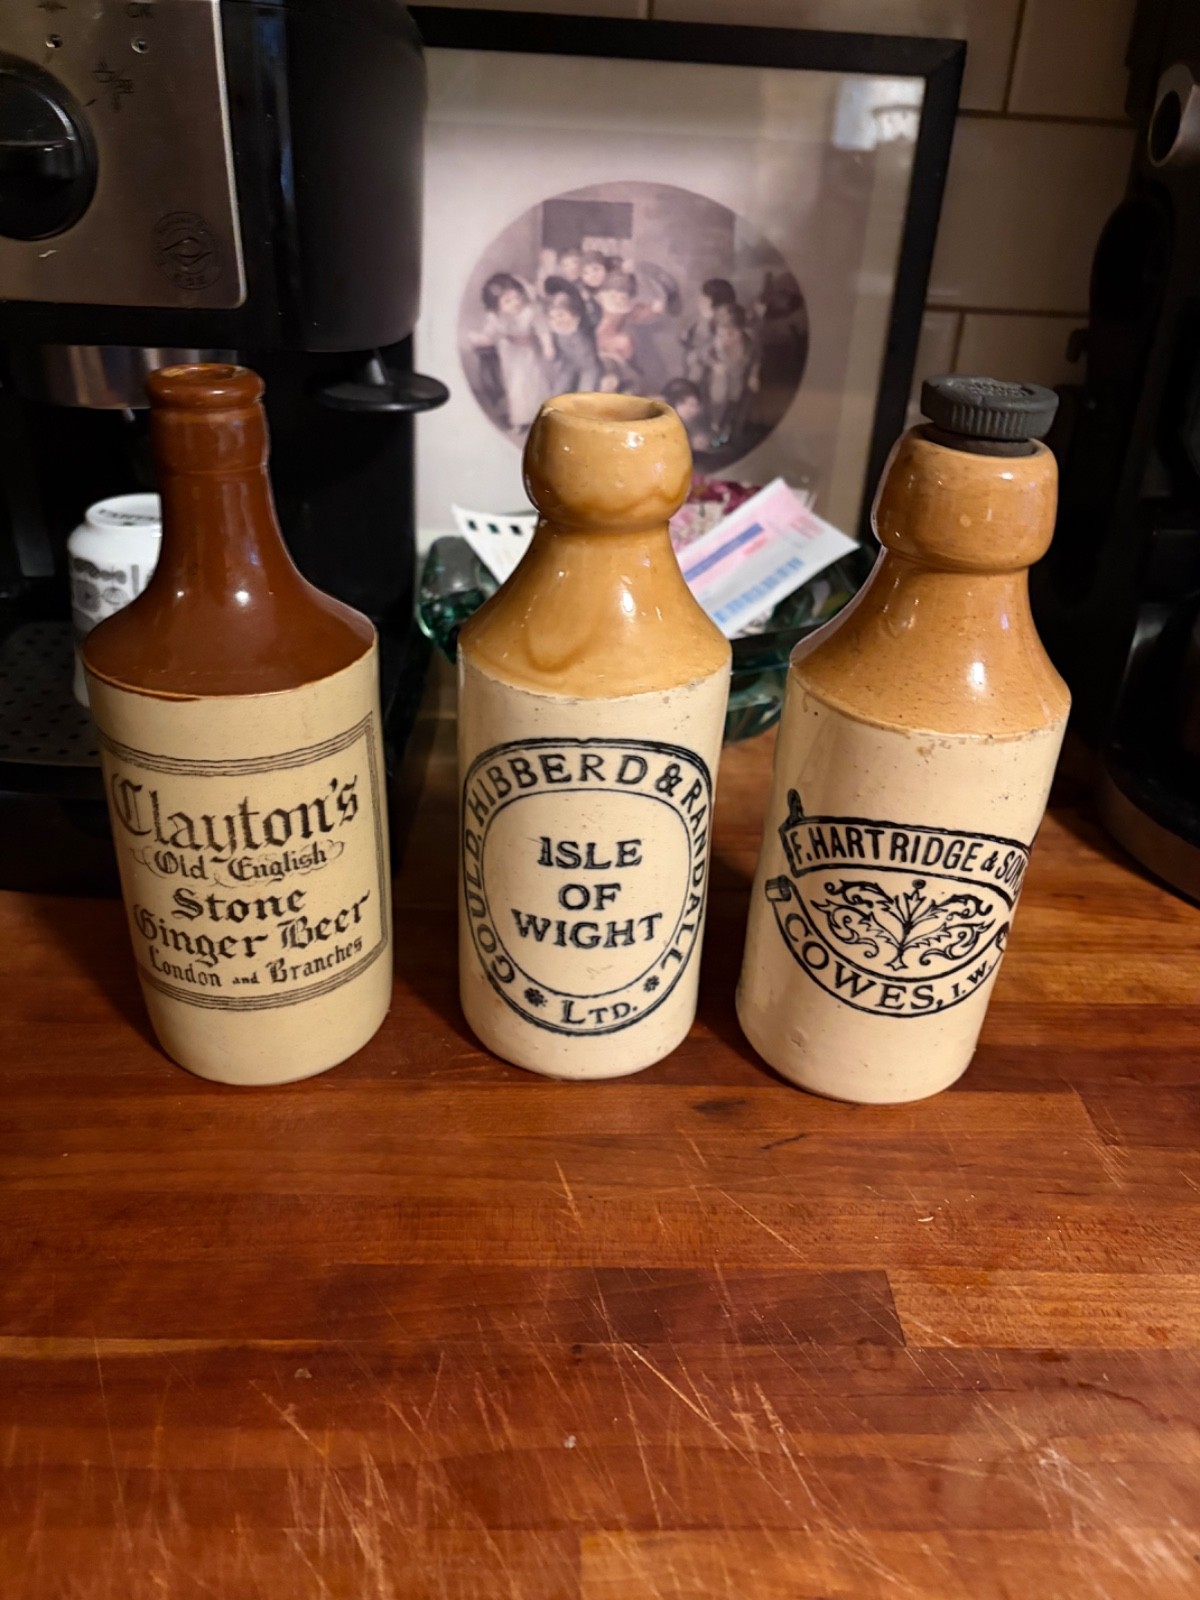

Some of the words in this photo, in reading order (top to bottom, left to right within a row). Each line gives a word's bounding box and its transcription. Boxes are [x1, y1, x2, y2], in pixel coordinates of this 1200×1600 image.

[467, 753, 648, 827] HIBBERD
[655, 763, 683, 797] &
[111, 774, 359, 862] Clayton's
[152, 850, 209, 880] Old
[227, 841, 328, 884] English
[537, 837, 642, 870] ISLE
[660, 778, 708, 969] RANDALL
[981, 850, 998, 872] &
[171, 887, 307, 923] Stone
[559, 883, 621, 911] OF
[134, 904, 268, 968] Ginger
[277, 889, 370, 949] Beer
[511, 908, 663, 950] WIGHT
[149, 945, 222, 987] London
[232, 971, 260, 985] and
[265, 936, 363, 983] Branches
[785, 913, 944, 1010] COWES,
